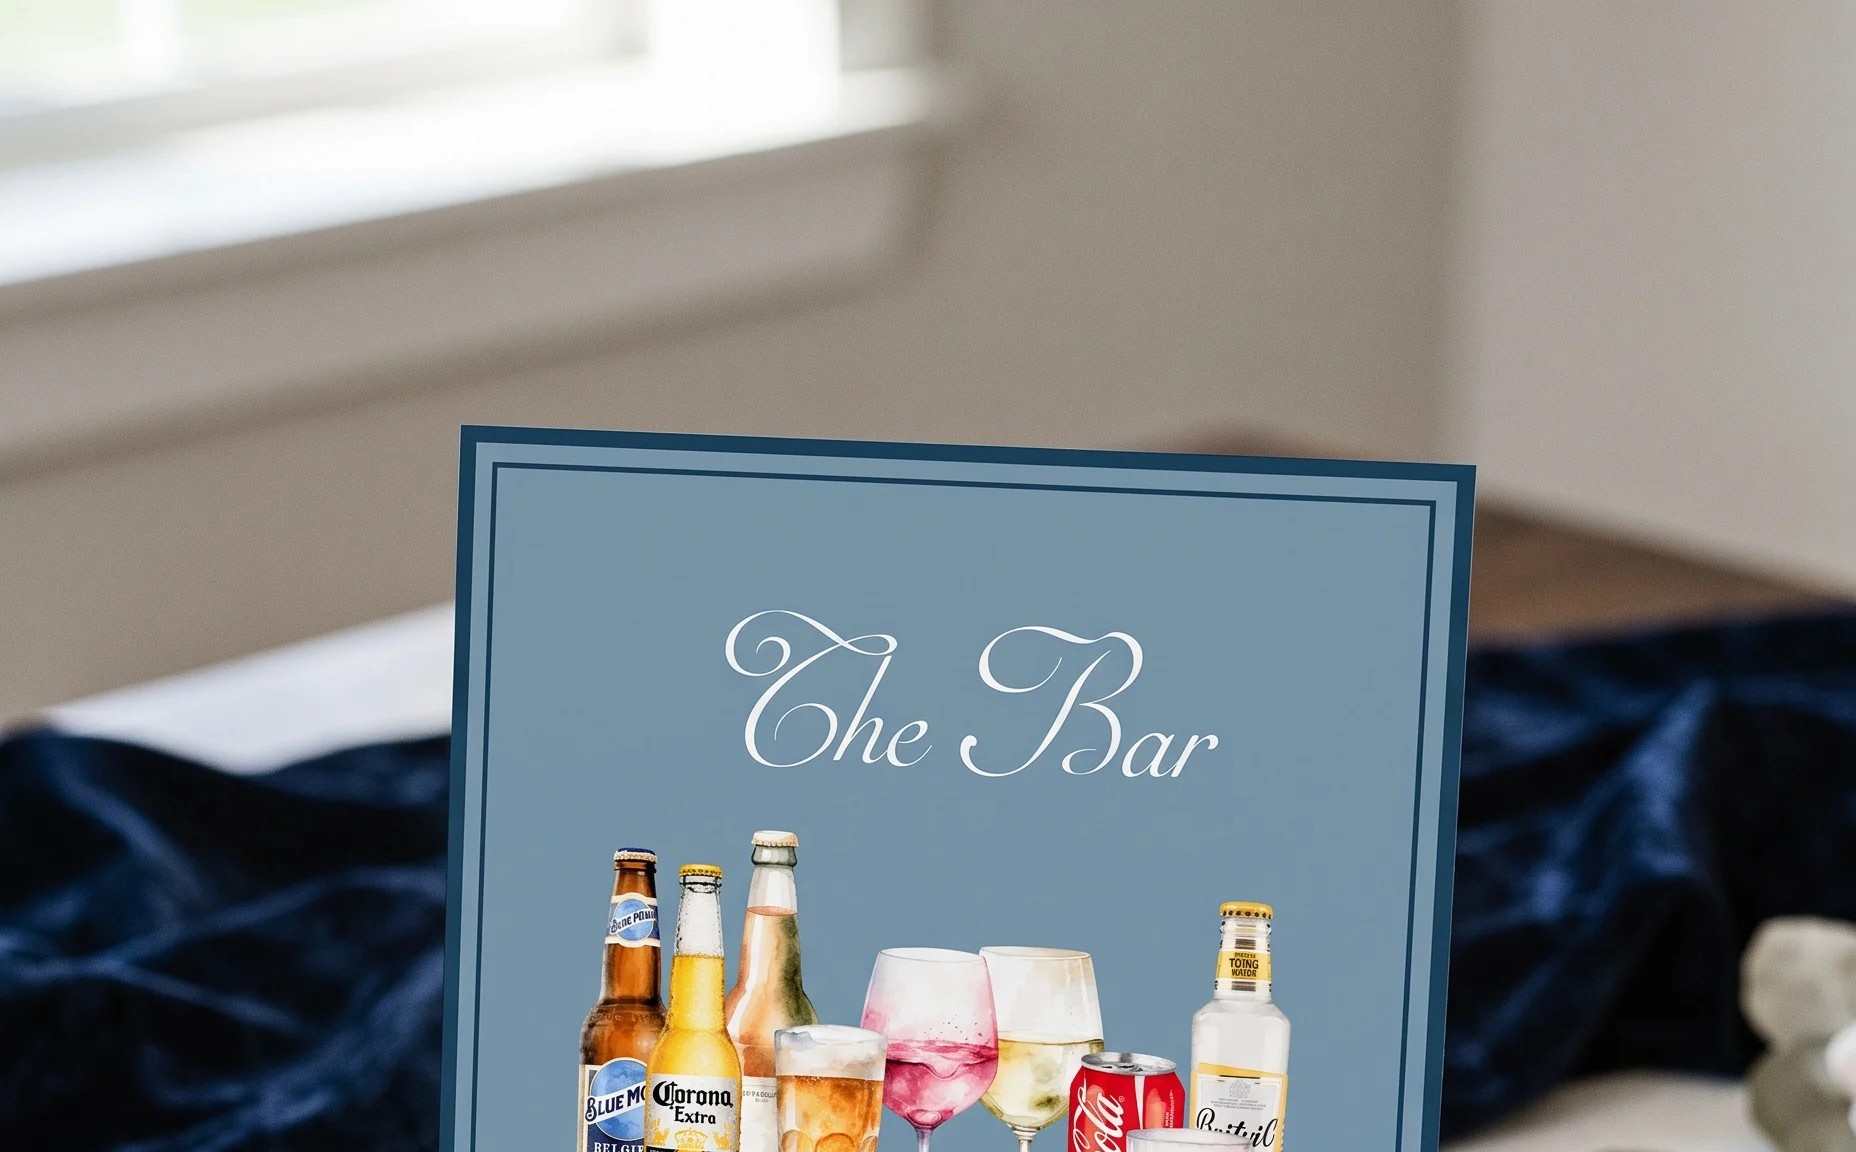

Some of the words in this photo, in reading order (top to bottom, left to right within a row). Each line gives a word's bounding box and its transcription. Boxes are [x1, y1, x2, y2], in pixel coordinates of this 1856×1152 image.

[724, 609, 932, 768] The
[960, 625, 1219, 778] Bar
[585, 1094, 625, 1122] BLUE
[652, 1080, 734, 1110] Corona
[674, 1105, 717, 1125] Extra
